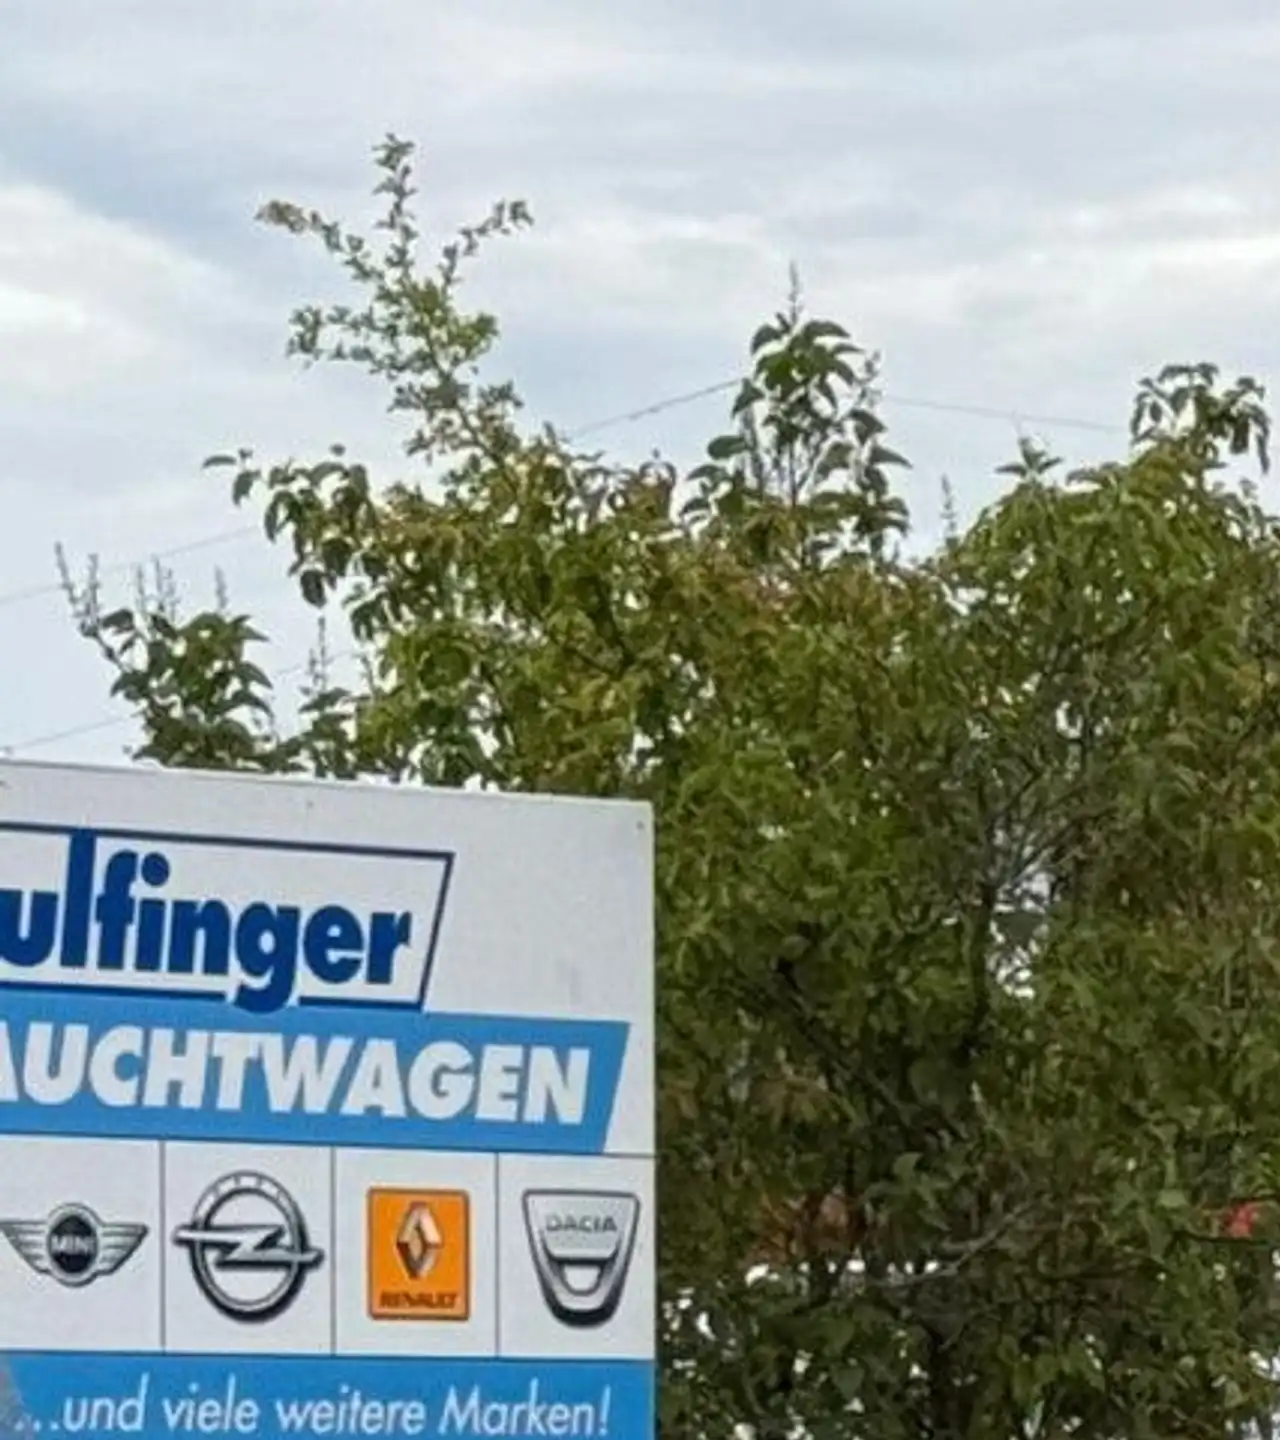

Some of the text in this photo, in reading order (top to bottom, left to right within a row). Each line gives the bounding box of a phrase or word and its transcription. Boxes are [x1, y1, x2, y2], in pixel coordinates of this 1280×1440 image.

[546, 1214, 619, 1233] DACIA
[163, 1375, 260, 1434] viele
[277, 1382, 426, 1436] weitere
[438, 1376, 611, 1438] Marken!
